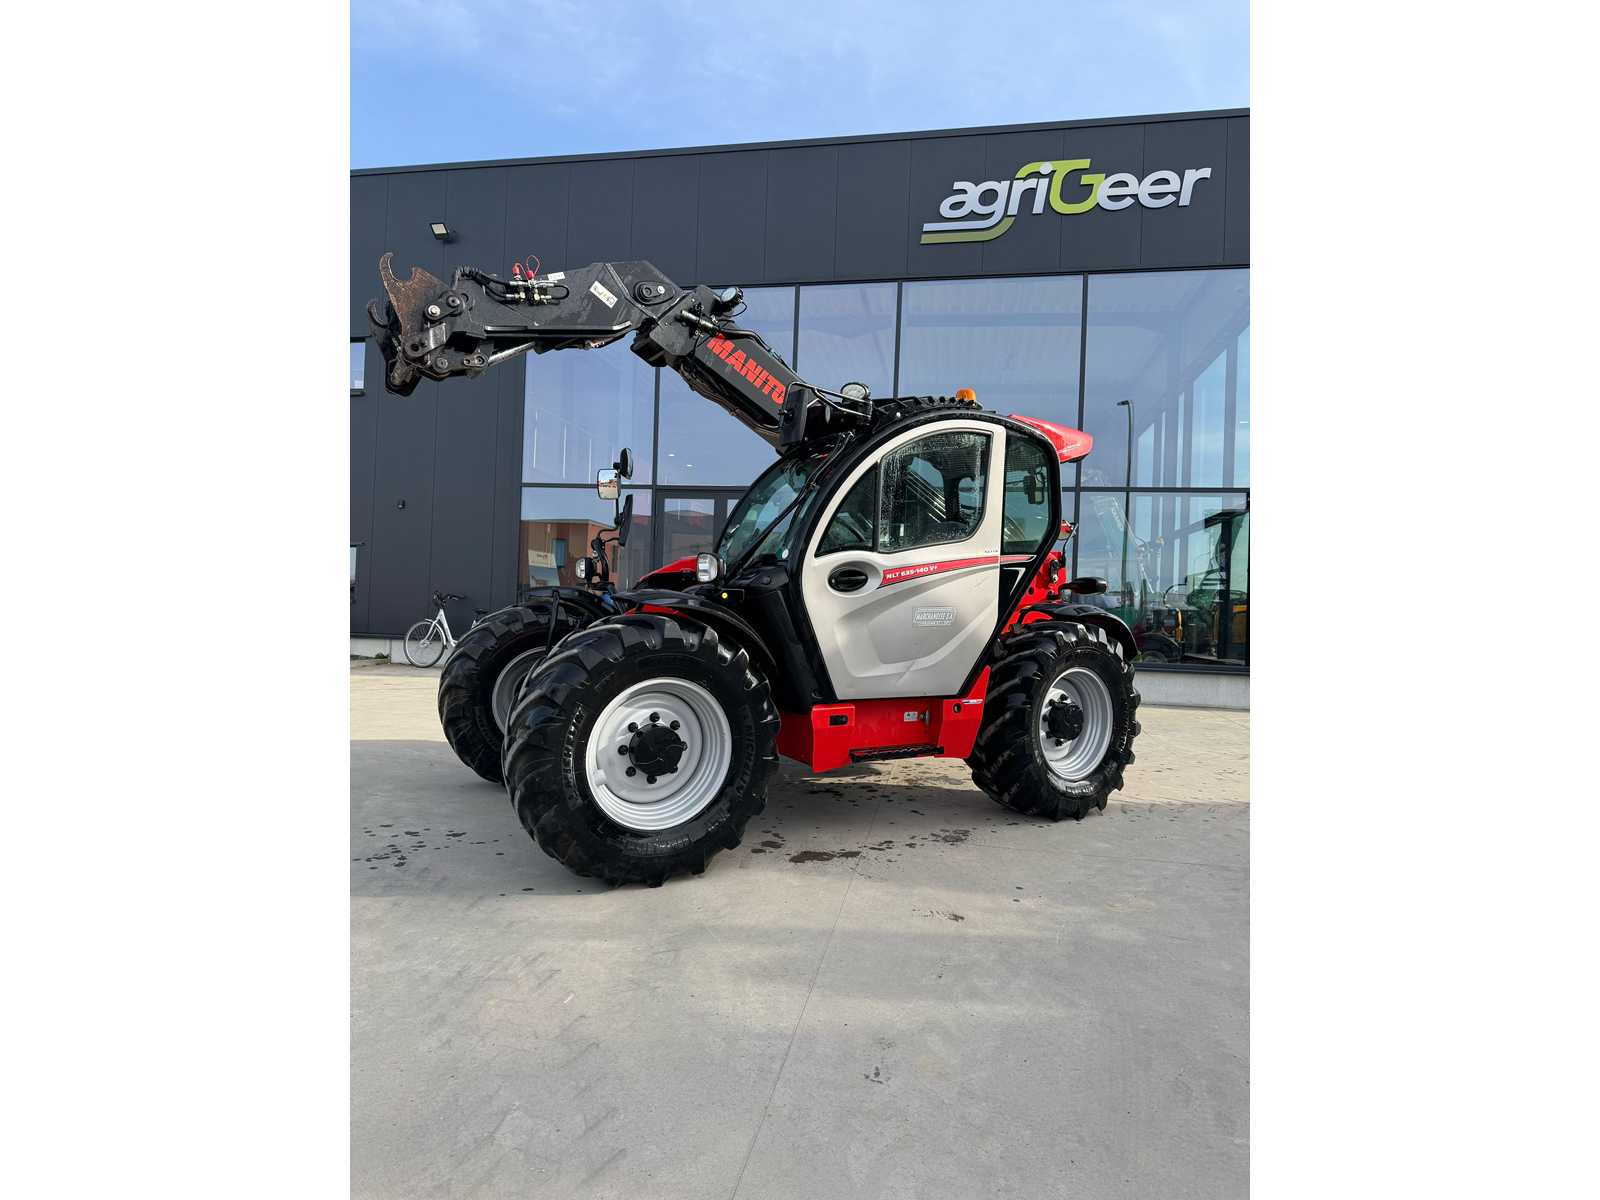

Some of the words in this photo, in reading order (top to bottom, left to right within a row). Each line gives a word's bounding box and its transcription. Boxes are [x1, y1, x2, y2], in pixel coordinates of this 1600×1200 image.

[706, 332, 786, 405] MANITO
[886, 571, 901, 580] MLT
[901, 567, 929, 577] 635-140
